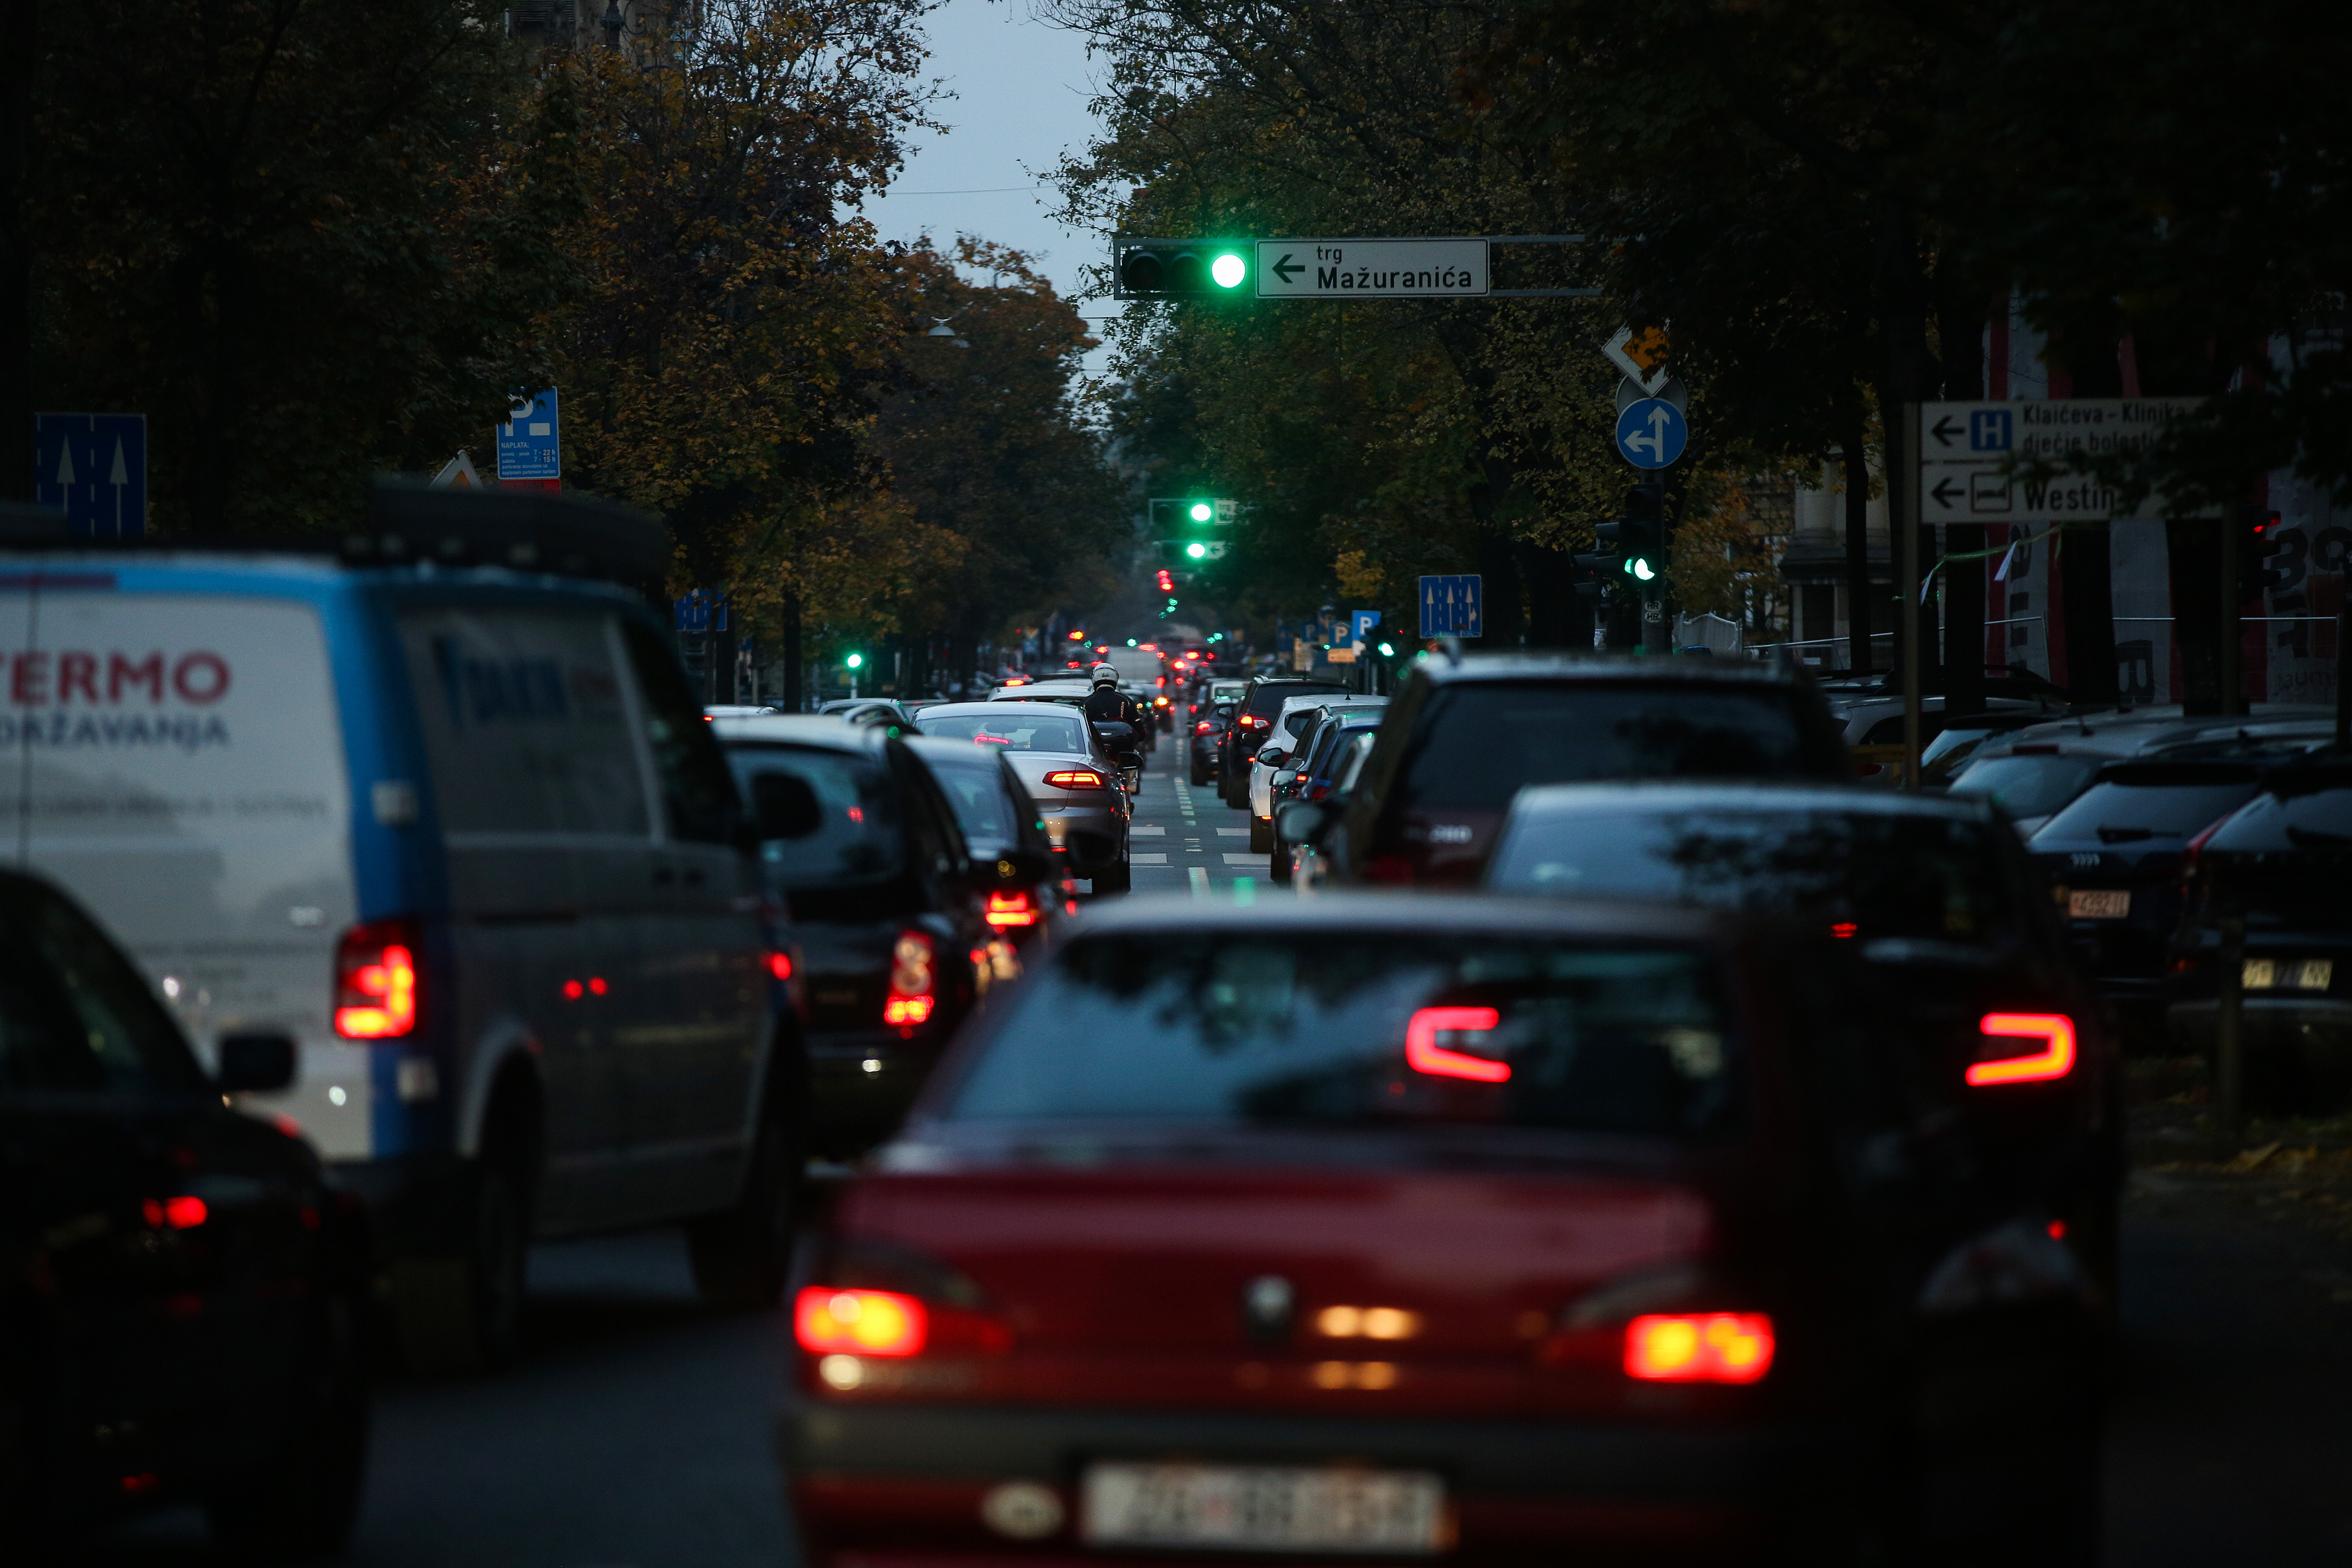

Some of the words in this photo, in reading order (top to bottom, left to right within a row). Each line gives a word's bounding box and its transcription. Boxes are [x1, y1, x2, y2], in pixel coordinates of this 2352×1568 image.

[1317, 245, 1342, 264] trg
[1318, 266, 1471, 289] Mažuranića
[1647, 601, 1659, 610] HR
[0, 650, 232, 706] ERMO
